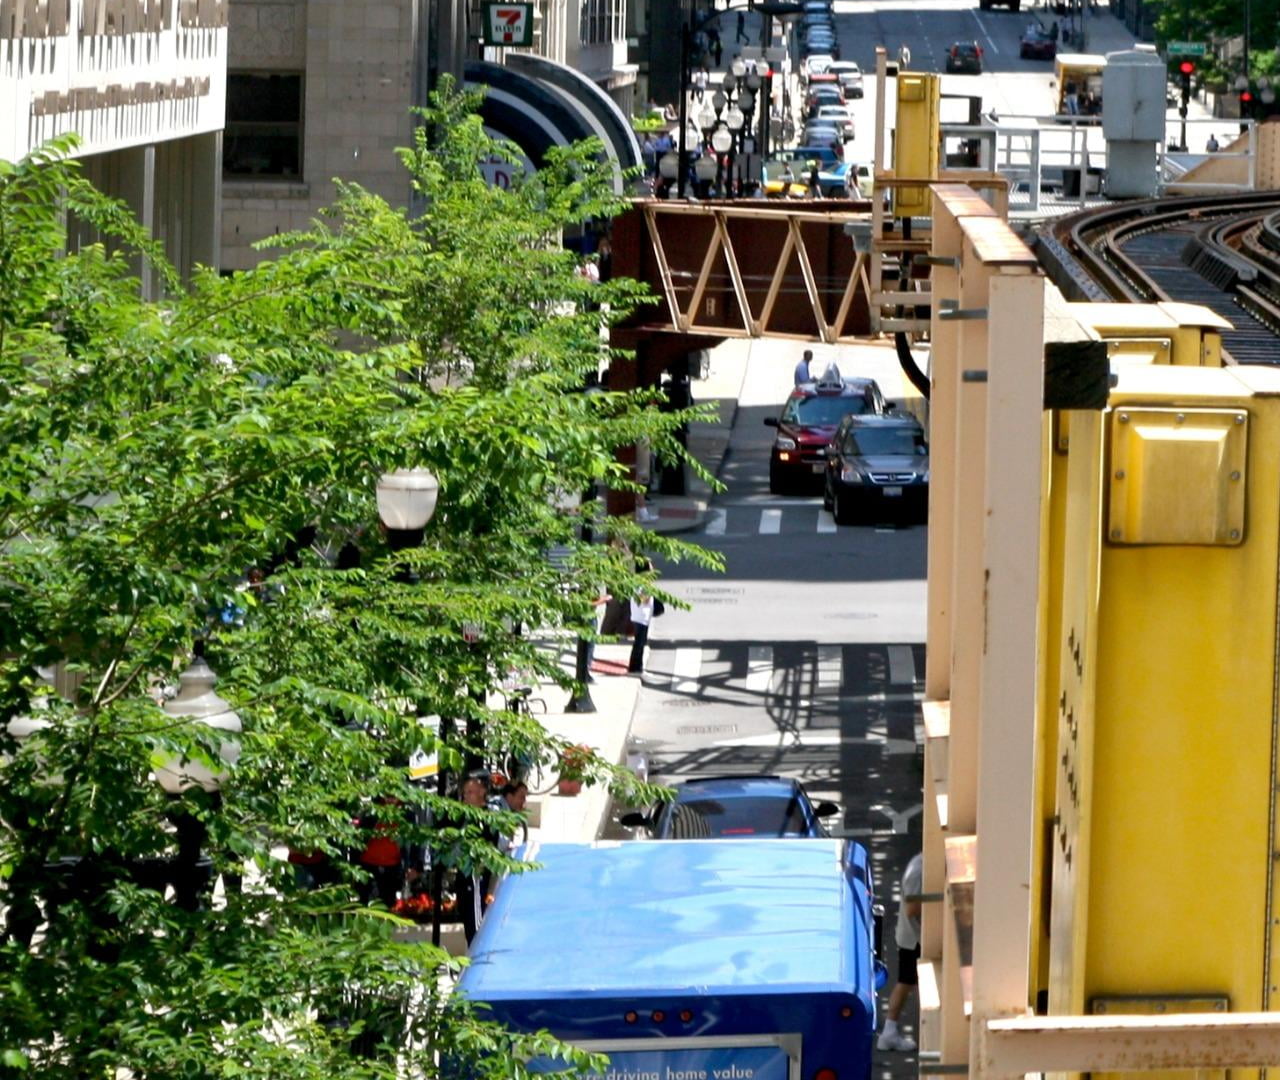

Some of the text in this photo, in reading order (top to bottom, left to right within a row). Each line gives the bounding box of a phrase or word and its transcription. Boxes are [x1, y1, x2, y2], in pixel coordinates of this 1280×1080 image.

[496, 10, 521, 41] 7
[607, 1068, 660, 1080] driving
[666, 1066, 707, 1080] home
[713, 1064, 753, 1079] value
